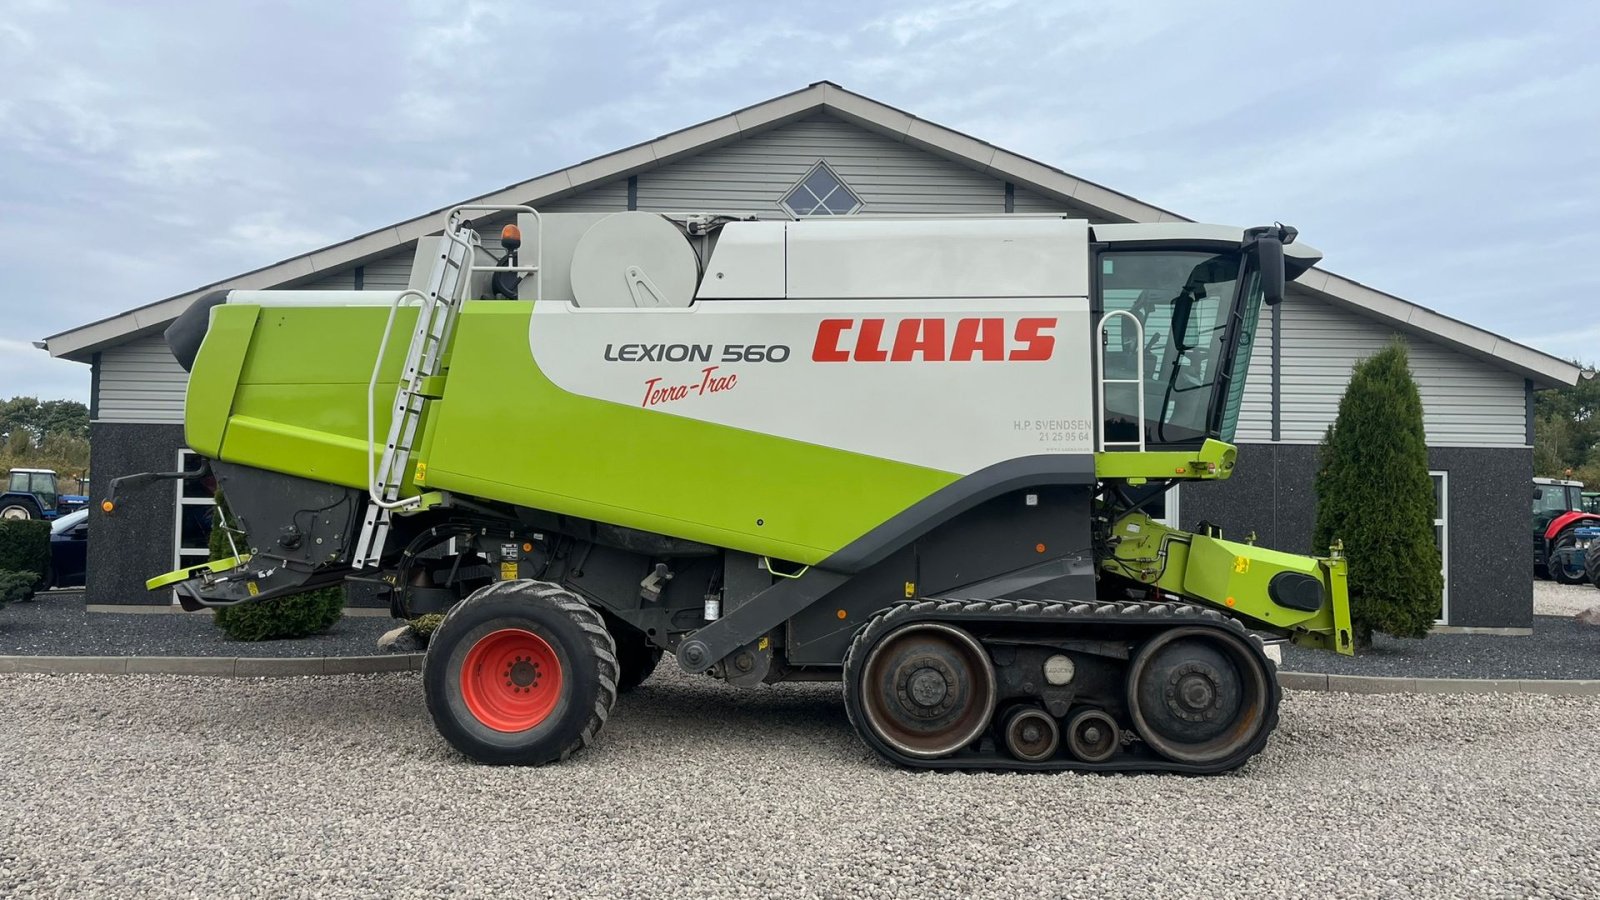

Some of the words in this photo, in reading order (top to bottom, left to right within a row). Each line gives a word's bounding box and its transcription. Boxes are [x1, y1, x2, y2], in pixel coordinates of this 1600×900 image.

[812, 318, 1058, 362] CLAAS
[604, 344, 713, 362] LEXION
[721, 344, 791, 363] 560
[642, 366, 737, 407] Terra-Trac
[1035, 420, 1092, 430] SVENDSEN
[1039, 432, 1049, 441] 21
[1052, 432, 1063, 441] 25
[1065, 432, 1076, 441] 95
[1078, 432, 1089, 441] 64
